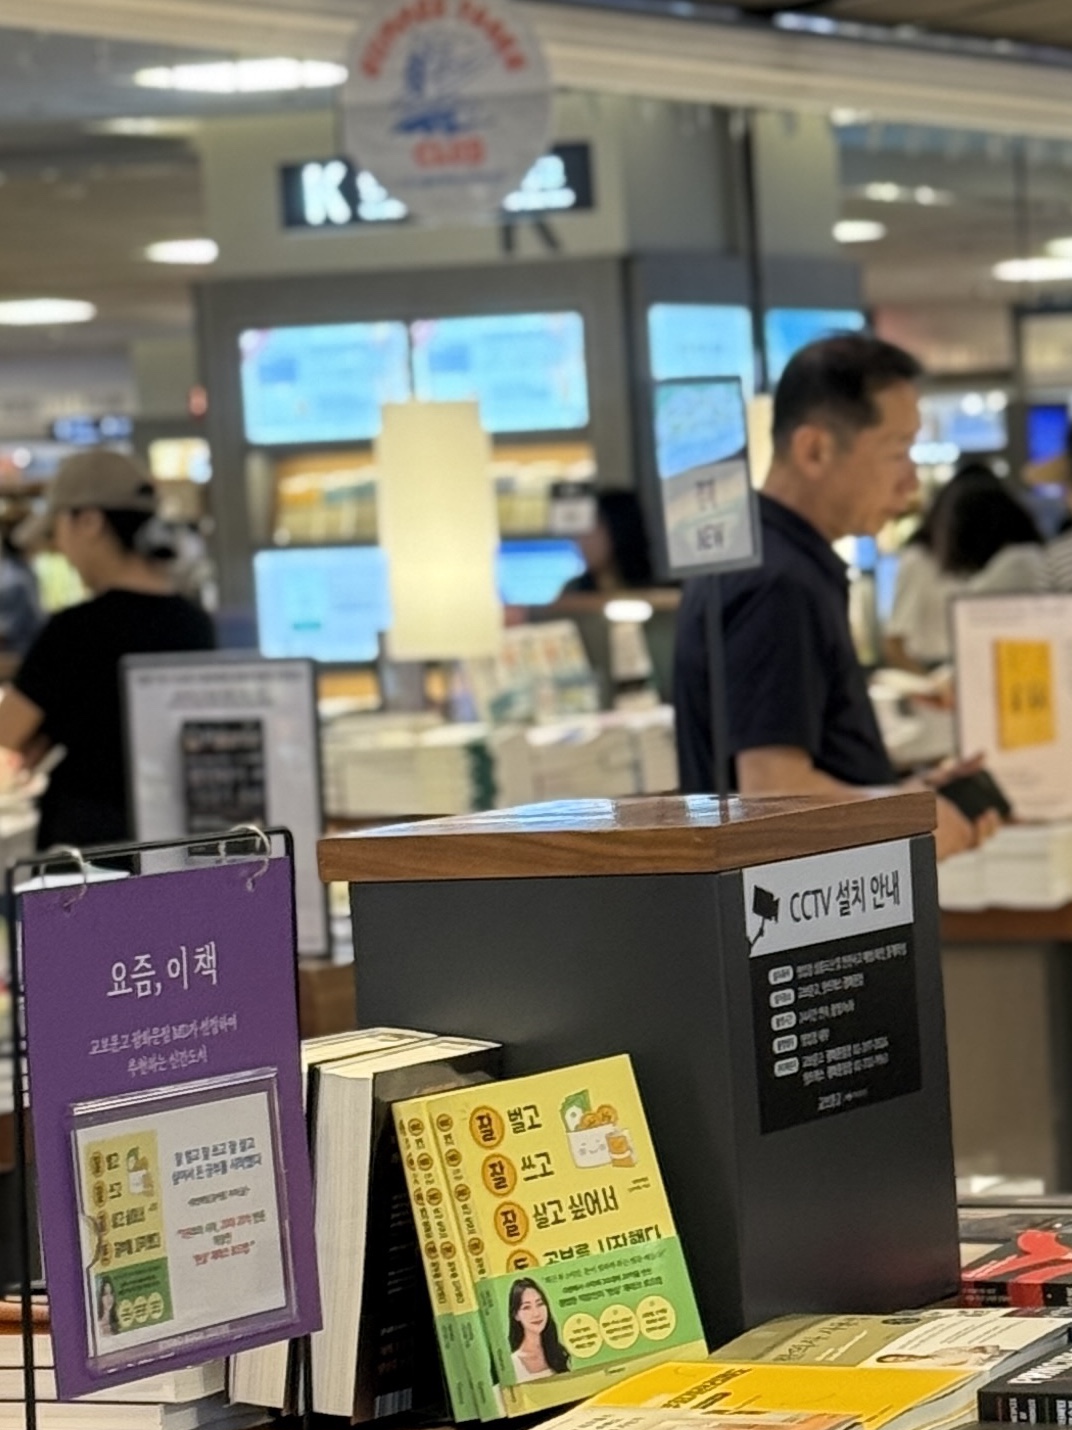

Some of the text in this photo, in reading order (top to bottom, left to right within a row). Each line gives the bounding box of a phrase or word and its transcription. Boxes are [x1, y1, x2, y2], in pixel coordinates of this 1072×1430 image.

[790, 870, 900, 922] CCTV 설치 안내
[106, 954, 162, 998] 요즘,
[475, 1104, 543, 1142] 잘 벌고
[488, 1151, 555, 1191] 잘 쓰고
[500, 1185, 619, 1239] 잘 살고 싶어서
